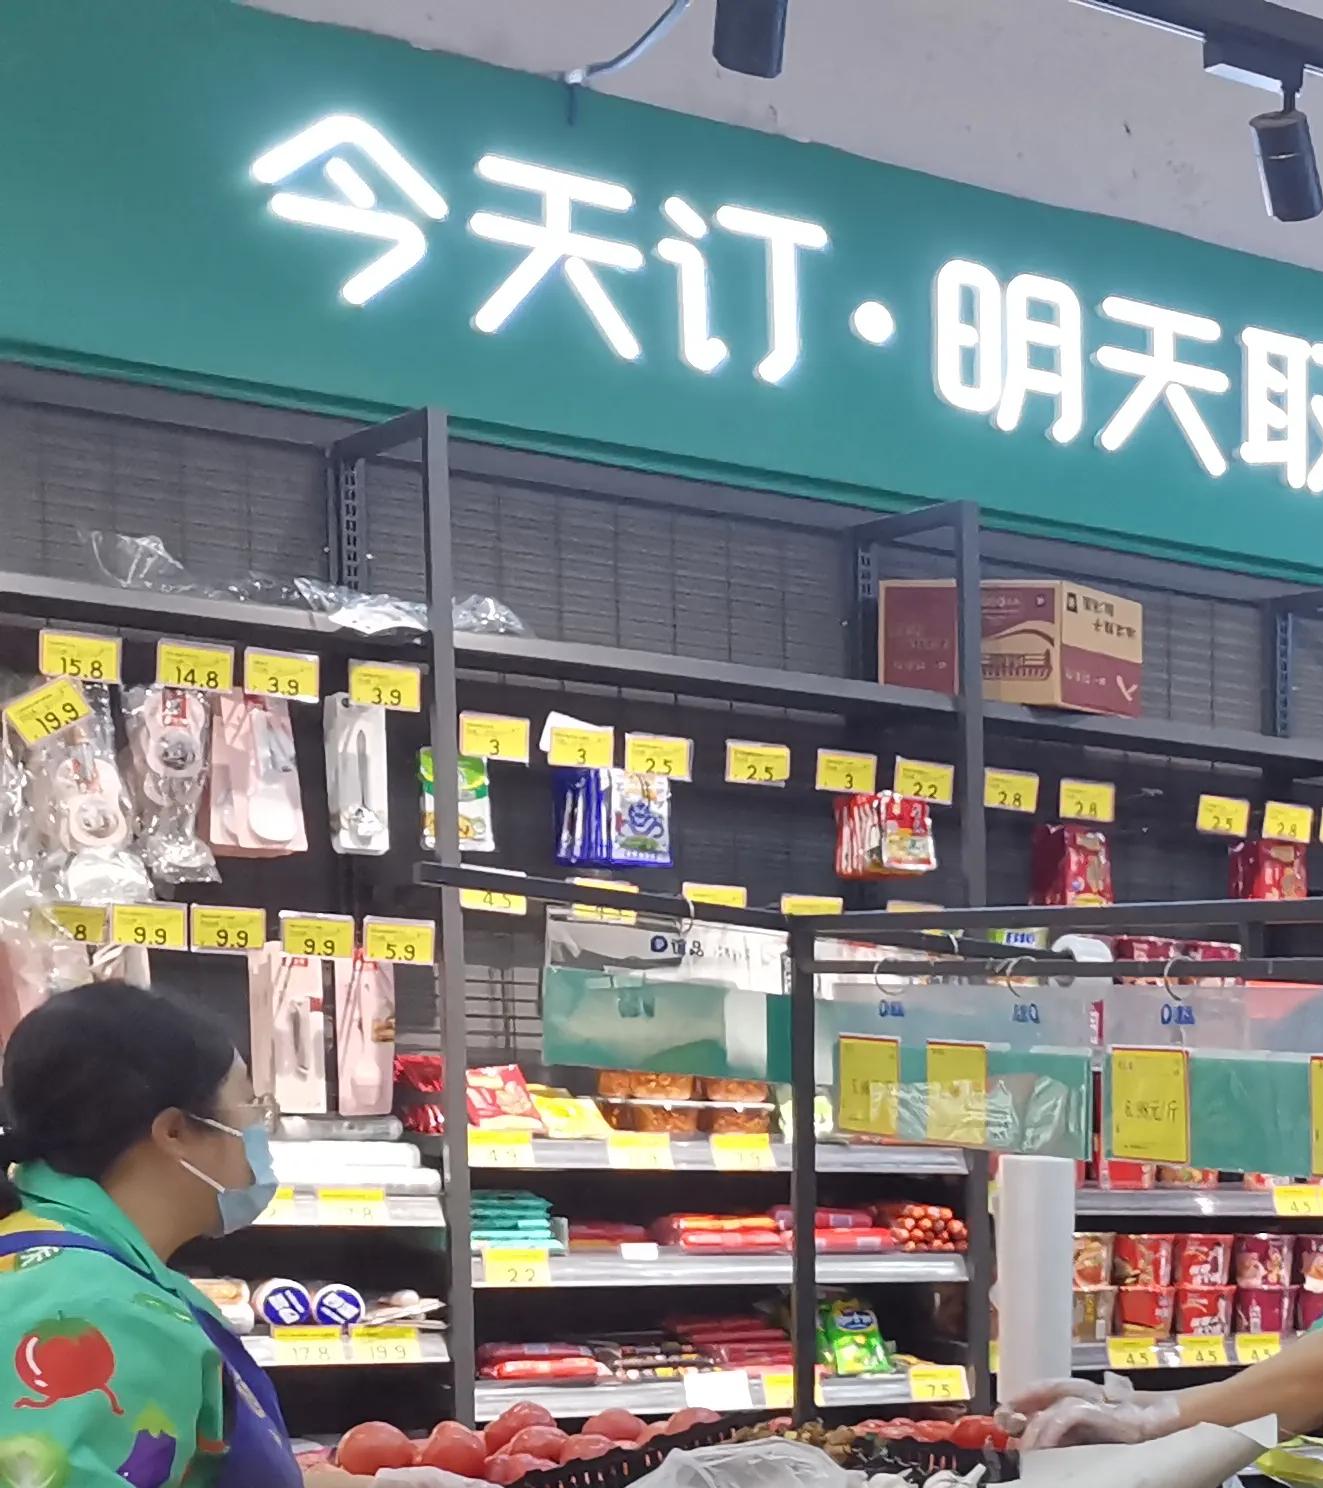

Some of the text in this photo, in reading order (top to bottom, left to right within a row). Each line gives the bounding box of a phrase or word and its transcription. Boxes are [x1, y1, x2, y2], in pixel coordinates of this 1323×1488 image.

[61, 657, 104, 679] 15.8
[176, 666, 219, 689] 14.8
[267, 677, 299, 696] 3.9
[371, 687, 402, 706] 3.9
[36, 702, 80, 735] 19.9
[489, 739, 500, 755] 3
[577, 748, 587, 765] 3
[844, 773, 854, 789] 3
[134, 926, 168, 945] 9.9
[216, 928, 249, 948] 9.9
[303, 938, 336, 957] 9.9
[385, 943, 416, 961] 5.9
